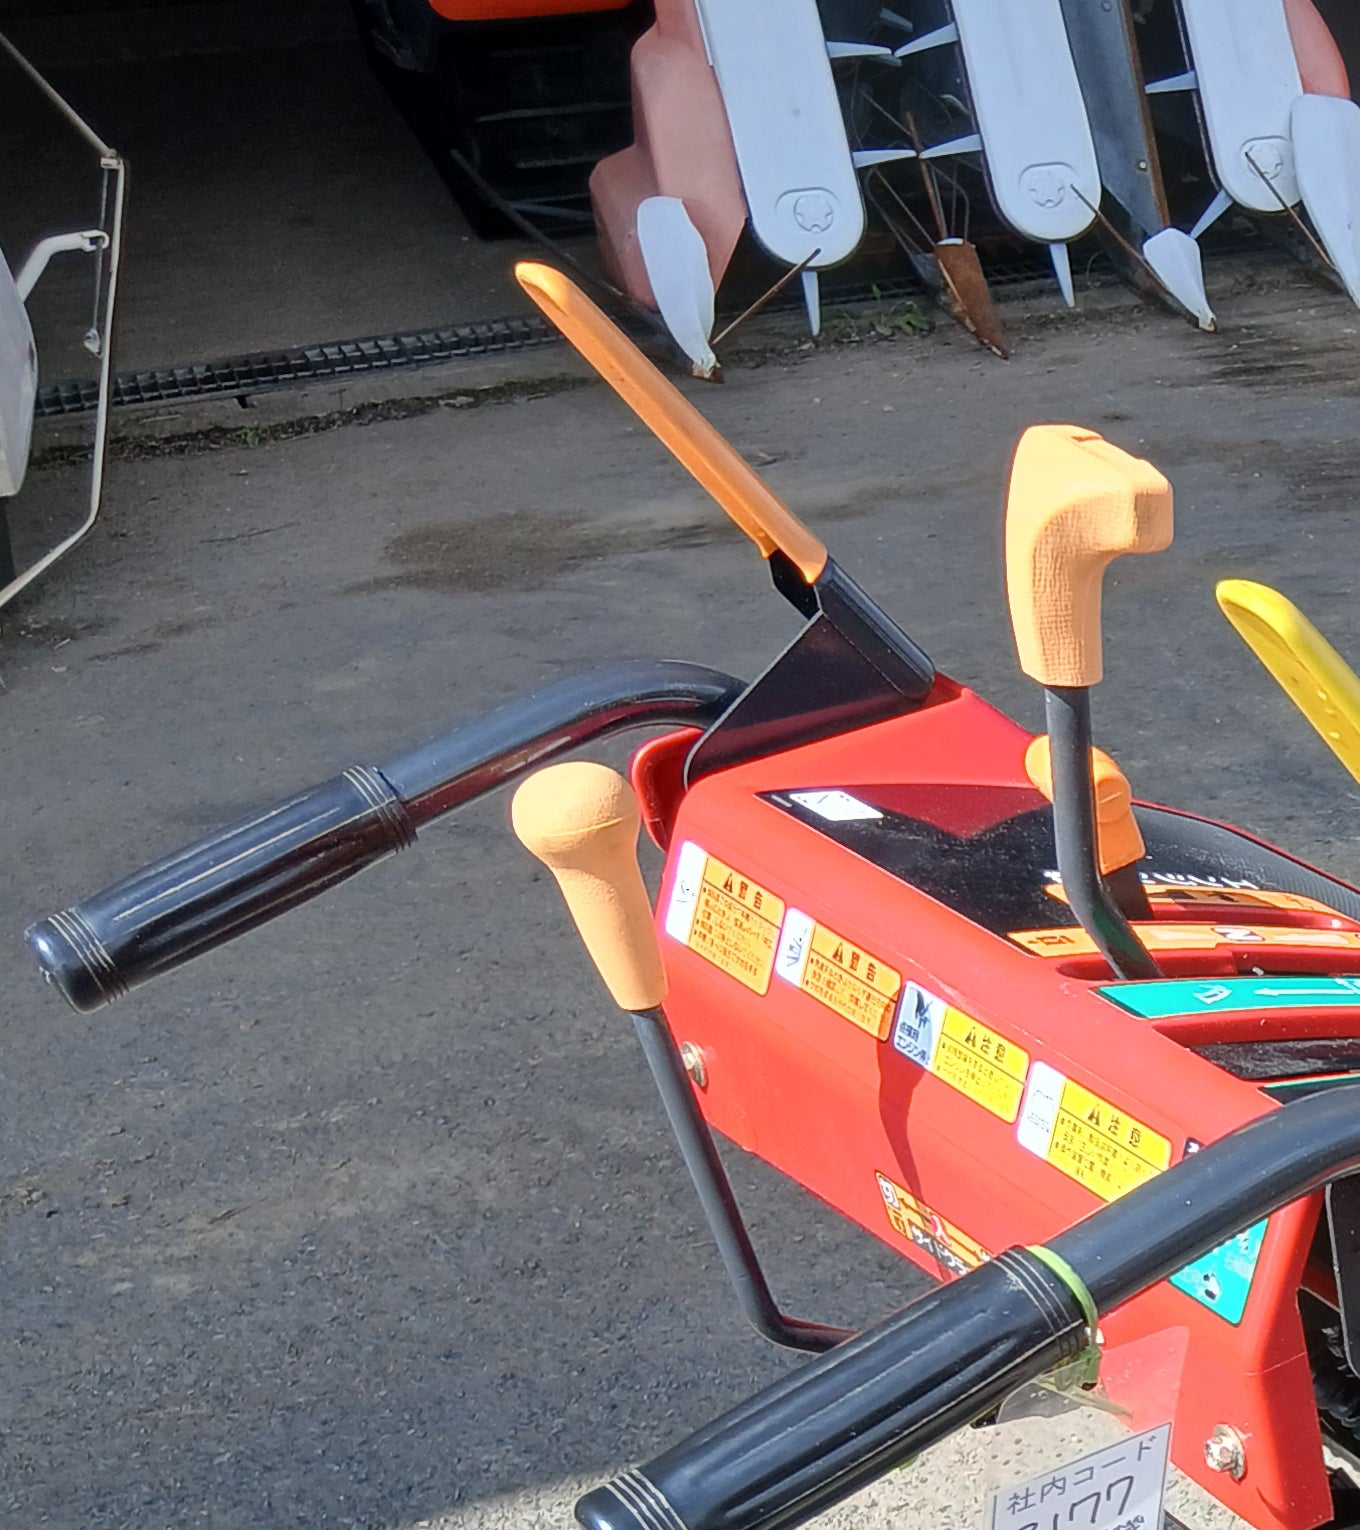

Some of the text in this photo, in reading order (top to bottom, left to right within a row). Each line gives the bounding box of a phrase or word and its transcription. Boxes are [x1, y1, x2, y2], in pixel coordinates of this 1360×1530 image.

[1007, 1436, 1157, 1515] 社内コード
